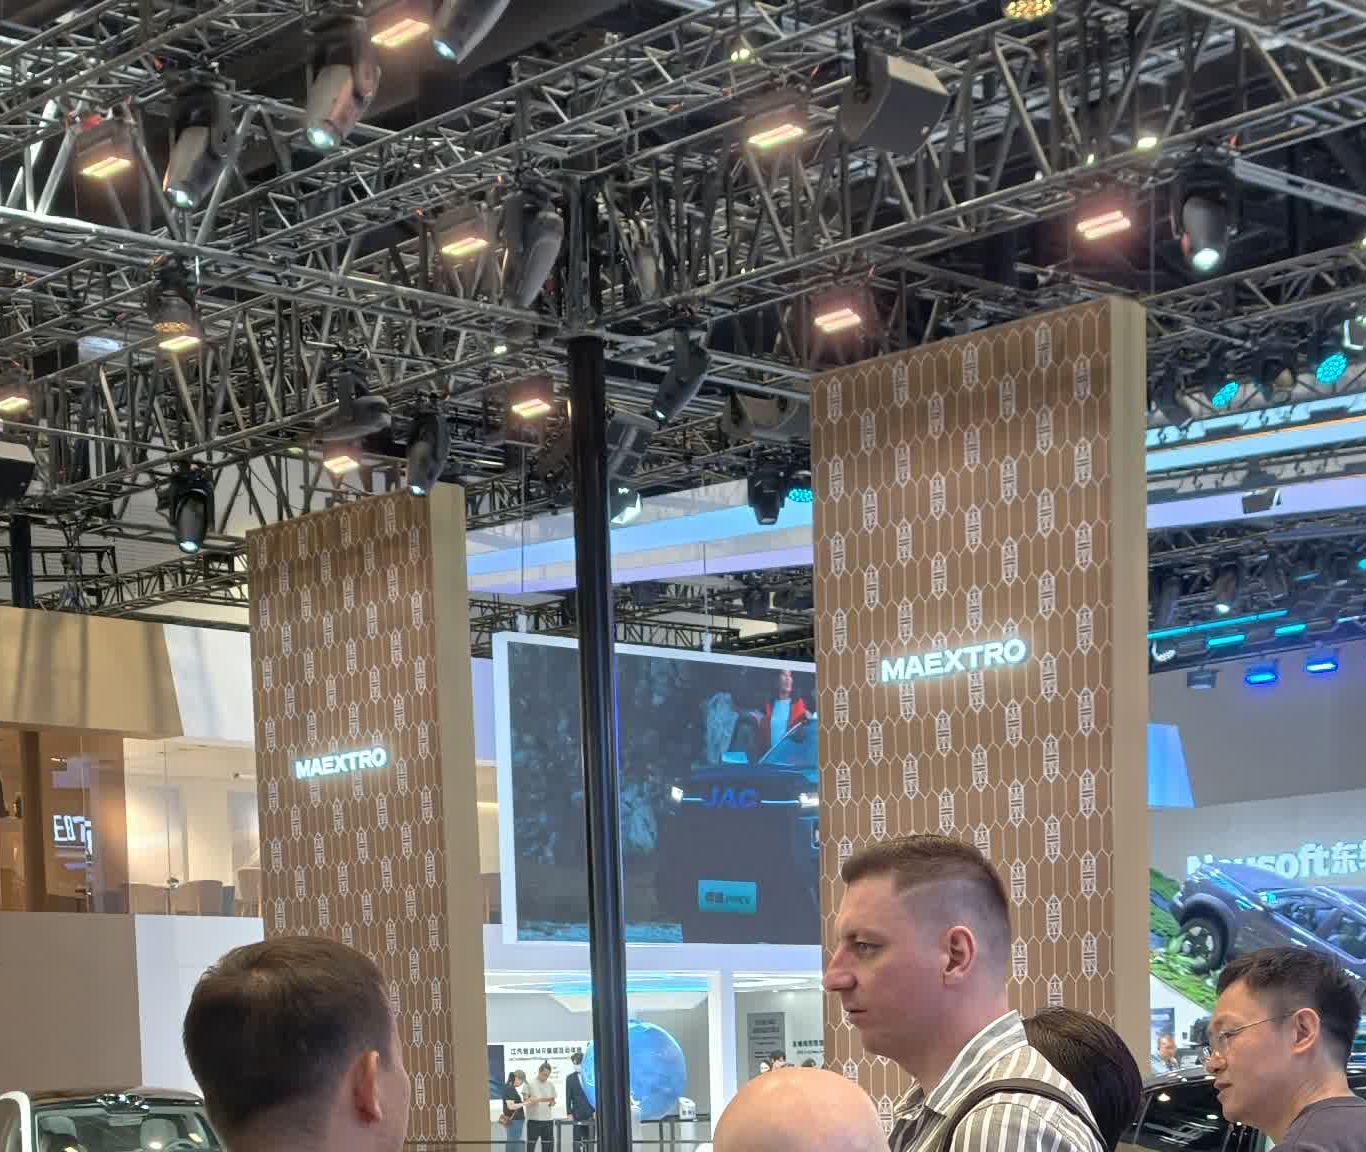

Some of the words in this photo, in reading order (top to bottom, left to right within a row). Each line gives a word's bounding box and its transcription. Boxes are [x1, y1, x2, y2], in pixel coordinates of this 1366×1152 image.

[881, 639, 1026, 682] MAEXTRO
[295, 747, 387, 779] MAEXTRO
[703, 786, 758, 809] JAC
